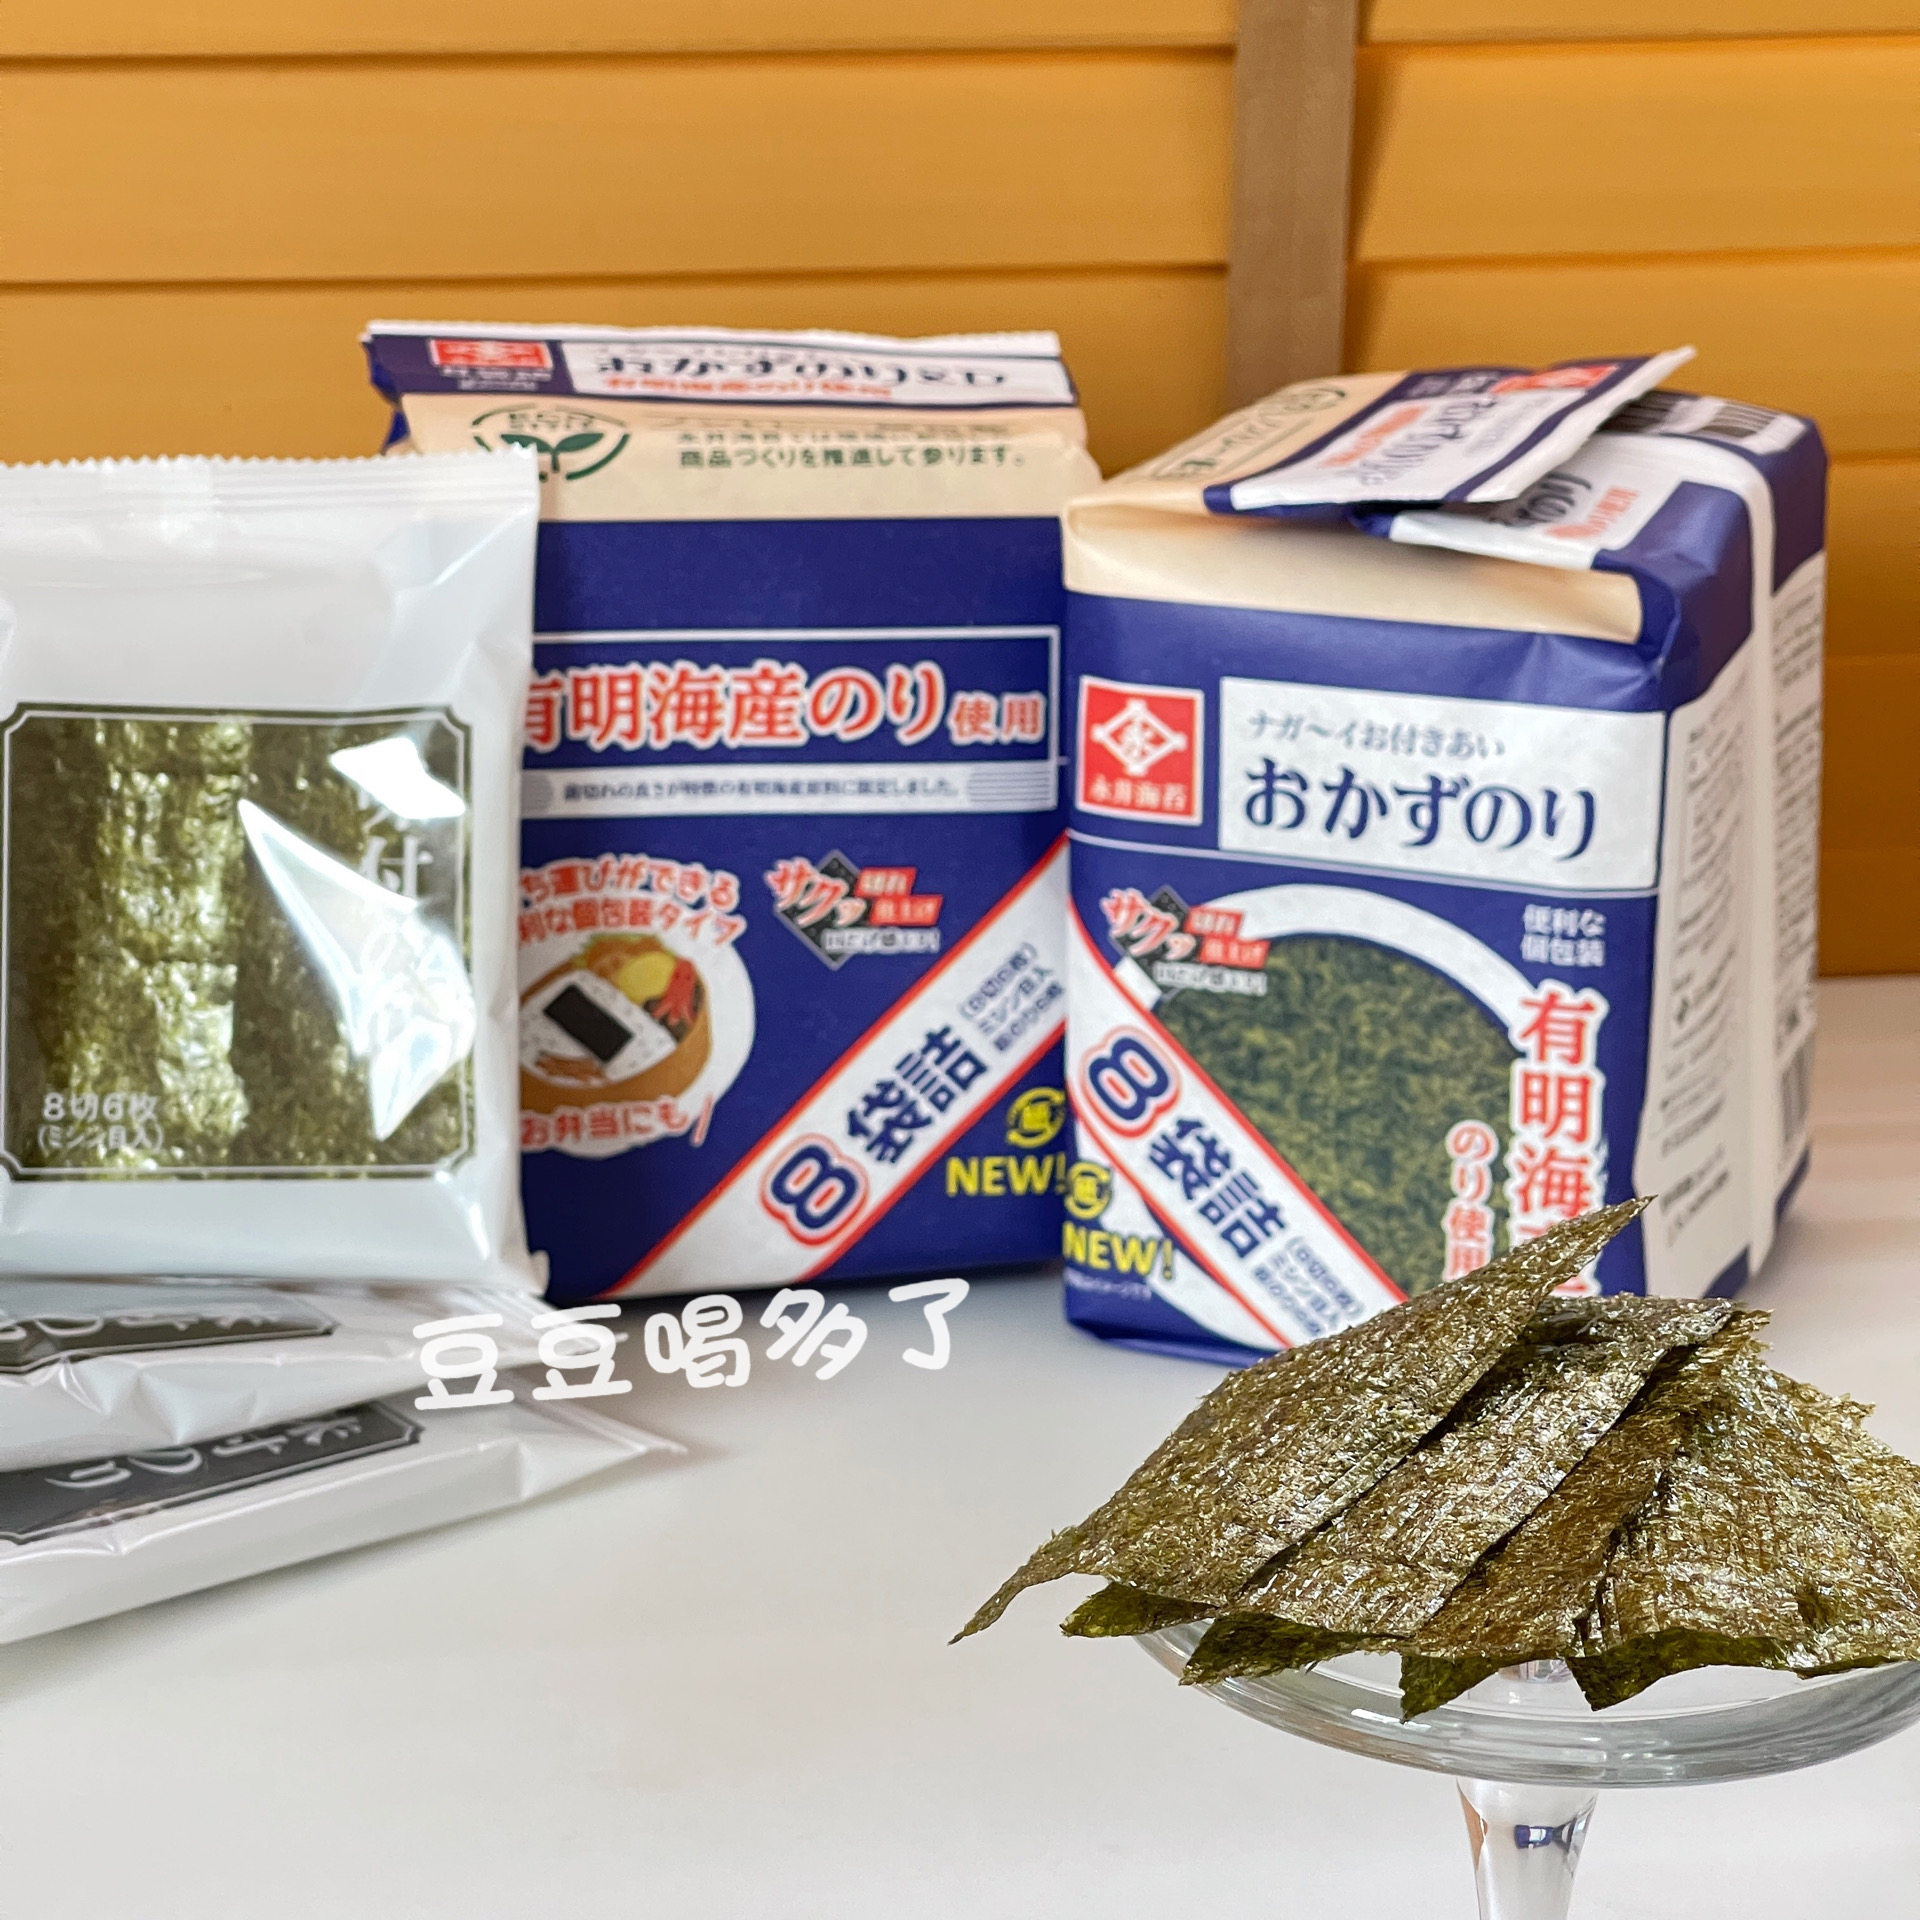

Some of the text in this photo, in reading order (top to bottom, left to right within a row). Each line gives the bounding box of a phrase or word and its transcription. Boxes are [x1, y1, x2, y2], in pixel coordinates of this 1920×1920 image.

[1243, 757, 1596, 862] おかずのり
[1522, 904, 1606, 937] 便利な
[1520, 934, 1606, 967] 個包装
[44, 1092, 158, 1121] 8切6枚
[764, 1024, 988, 1242] 8袋詰
[1082, 1030, 1286, 1260] 8袋詰
[947, 1155, 1066, 1196] NEW!
[1062, 1221, 1173, 1280] NEW!
